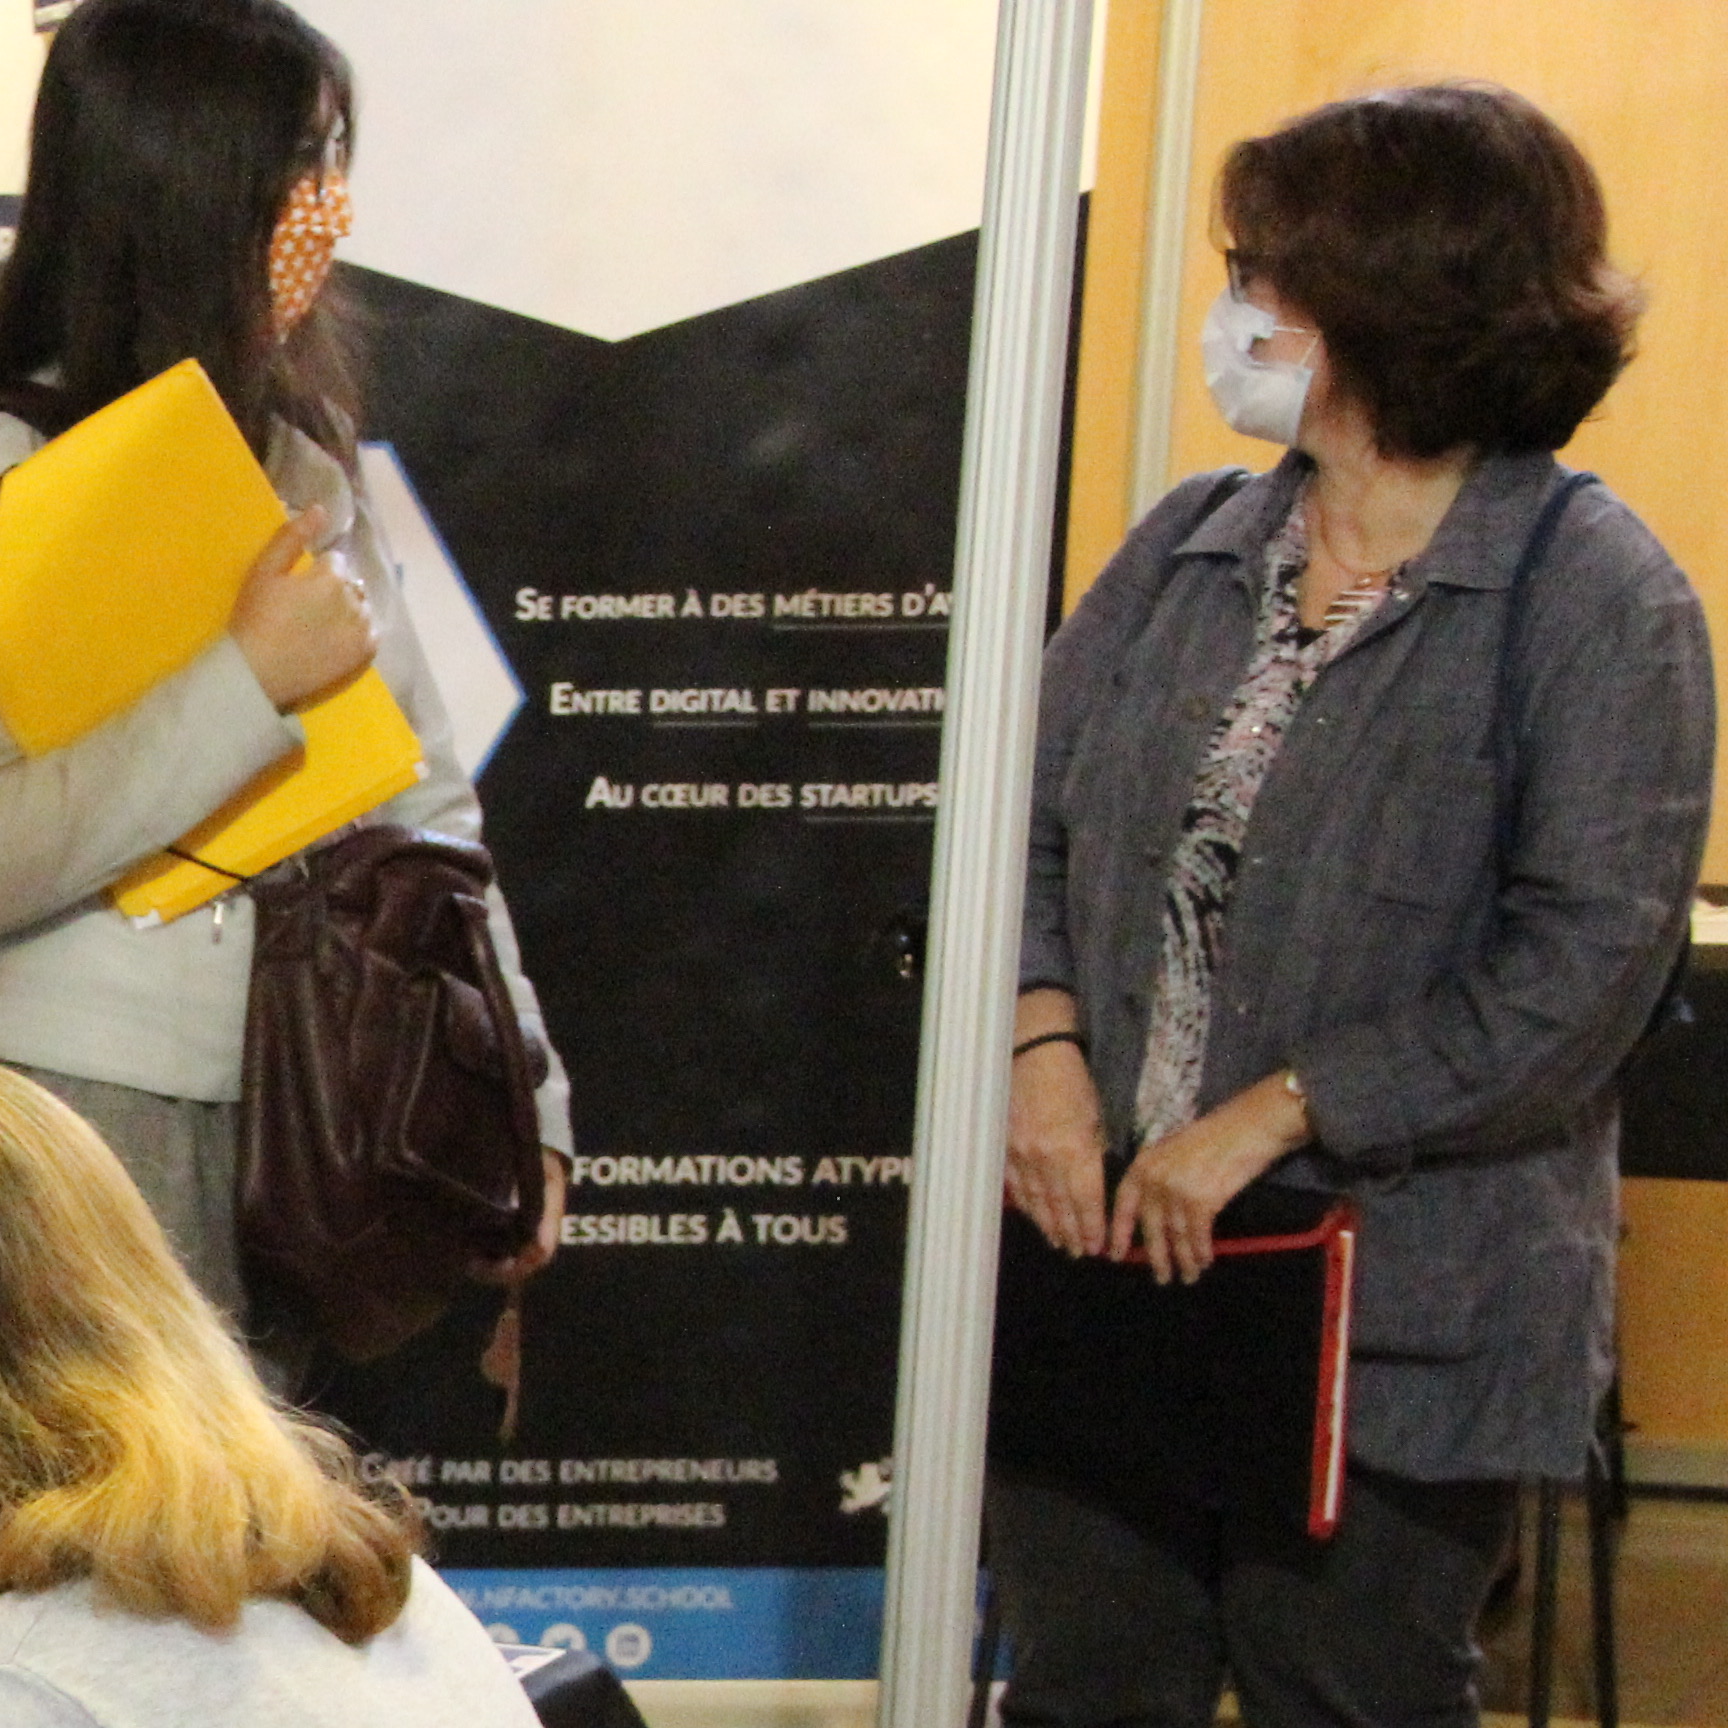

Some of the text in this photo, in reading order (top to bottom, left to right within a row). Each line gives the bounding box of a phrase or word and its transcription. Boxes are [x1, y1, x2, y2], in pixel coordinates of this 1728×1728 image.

[560, 593, 675, 619] FORMER
[681, 588, 704, 618] À
[711, 592, 765, 618] DES
[774, 587, 893, 618] MÉTIERS
[650, 687, 758, 714] DIGITAL
[766, 687, 798, 713] ET
[738, 783, 792, 808] DES
[800, 783, 939, 808] STARTUPS
[572, 1156, 804, 1186] FORMATIONS
[716, 1207, 744, 1244] À
[751, 1214, 848, 1244] TOUS
[499, 1460, 550, 1483] DES
[558, 1458, 779, 1483] ENTREPRENEURS
[497, 1503, 549, 1528] DES
[556, 1502, 727, 1528] ENTREPRISES
